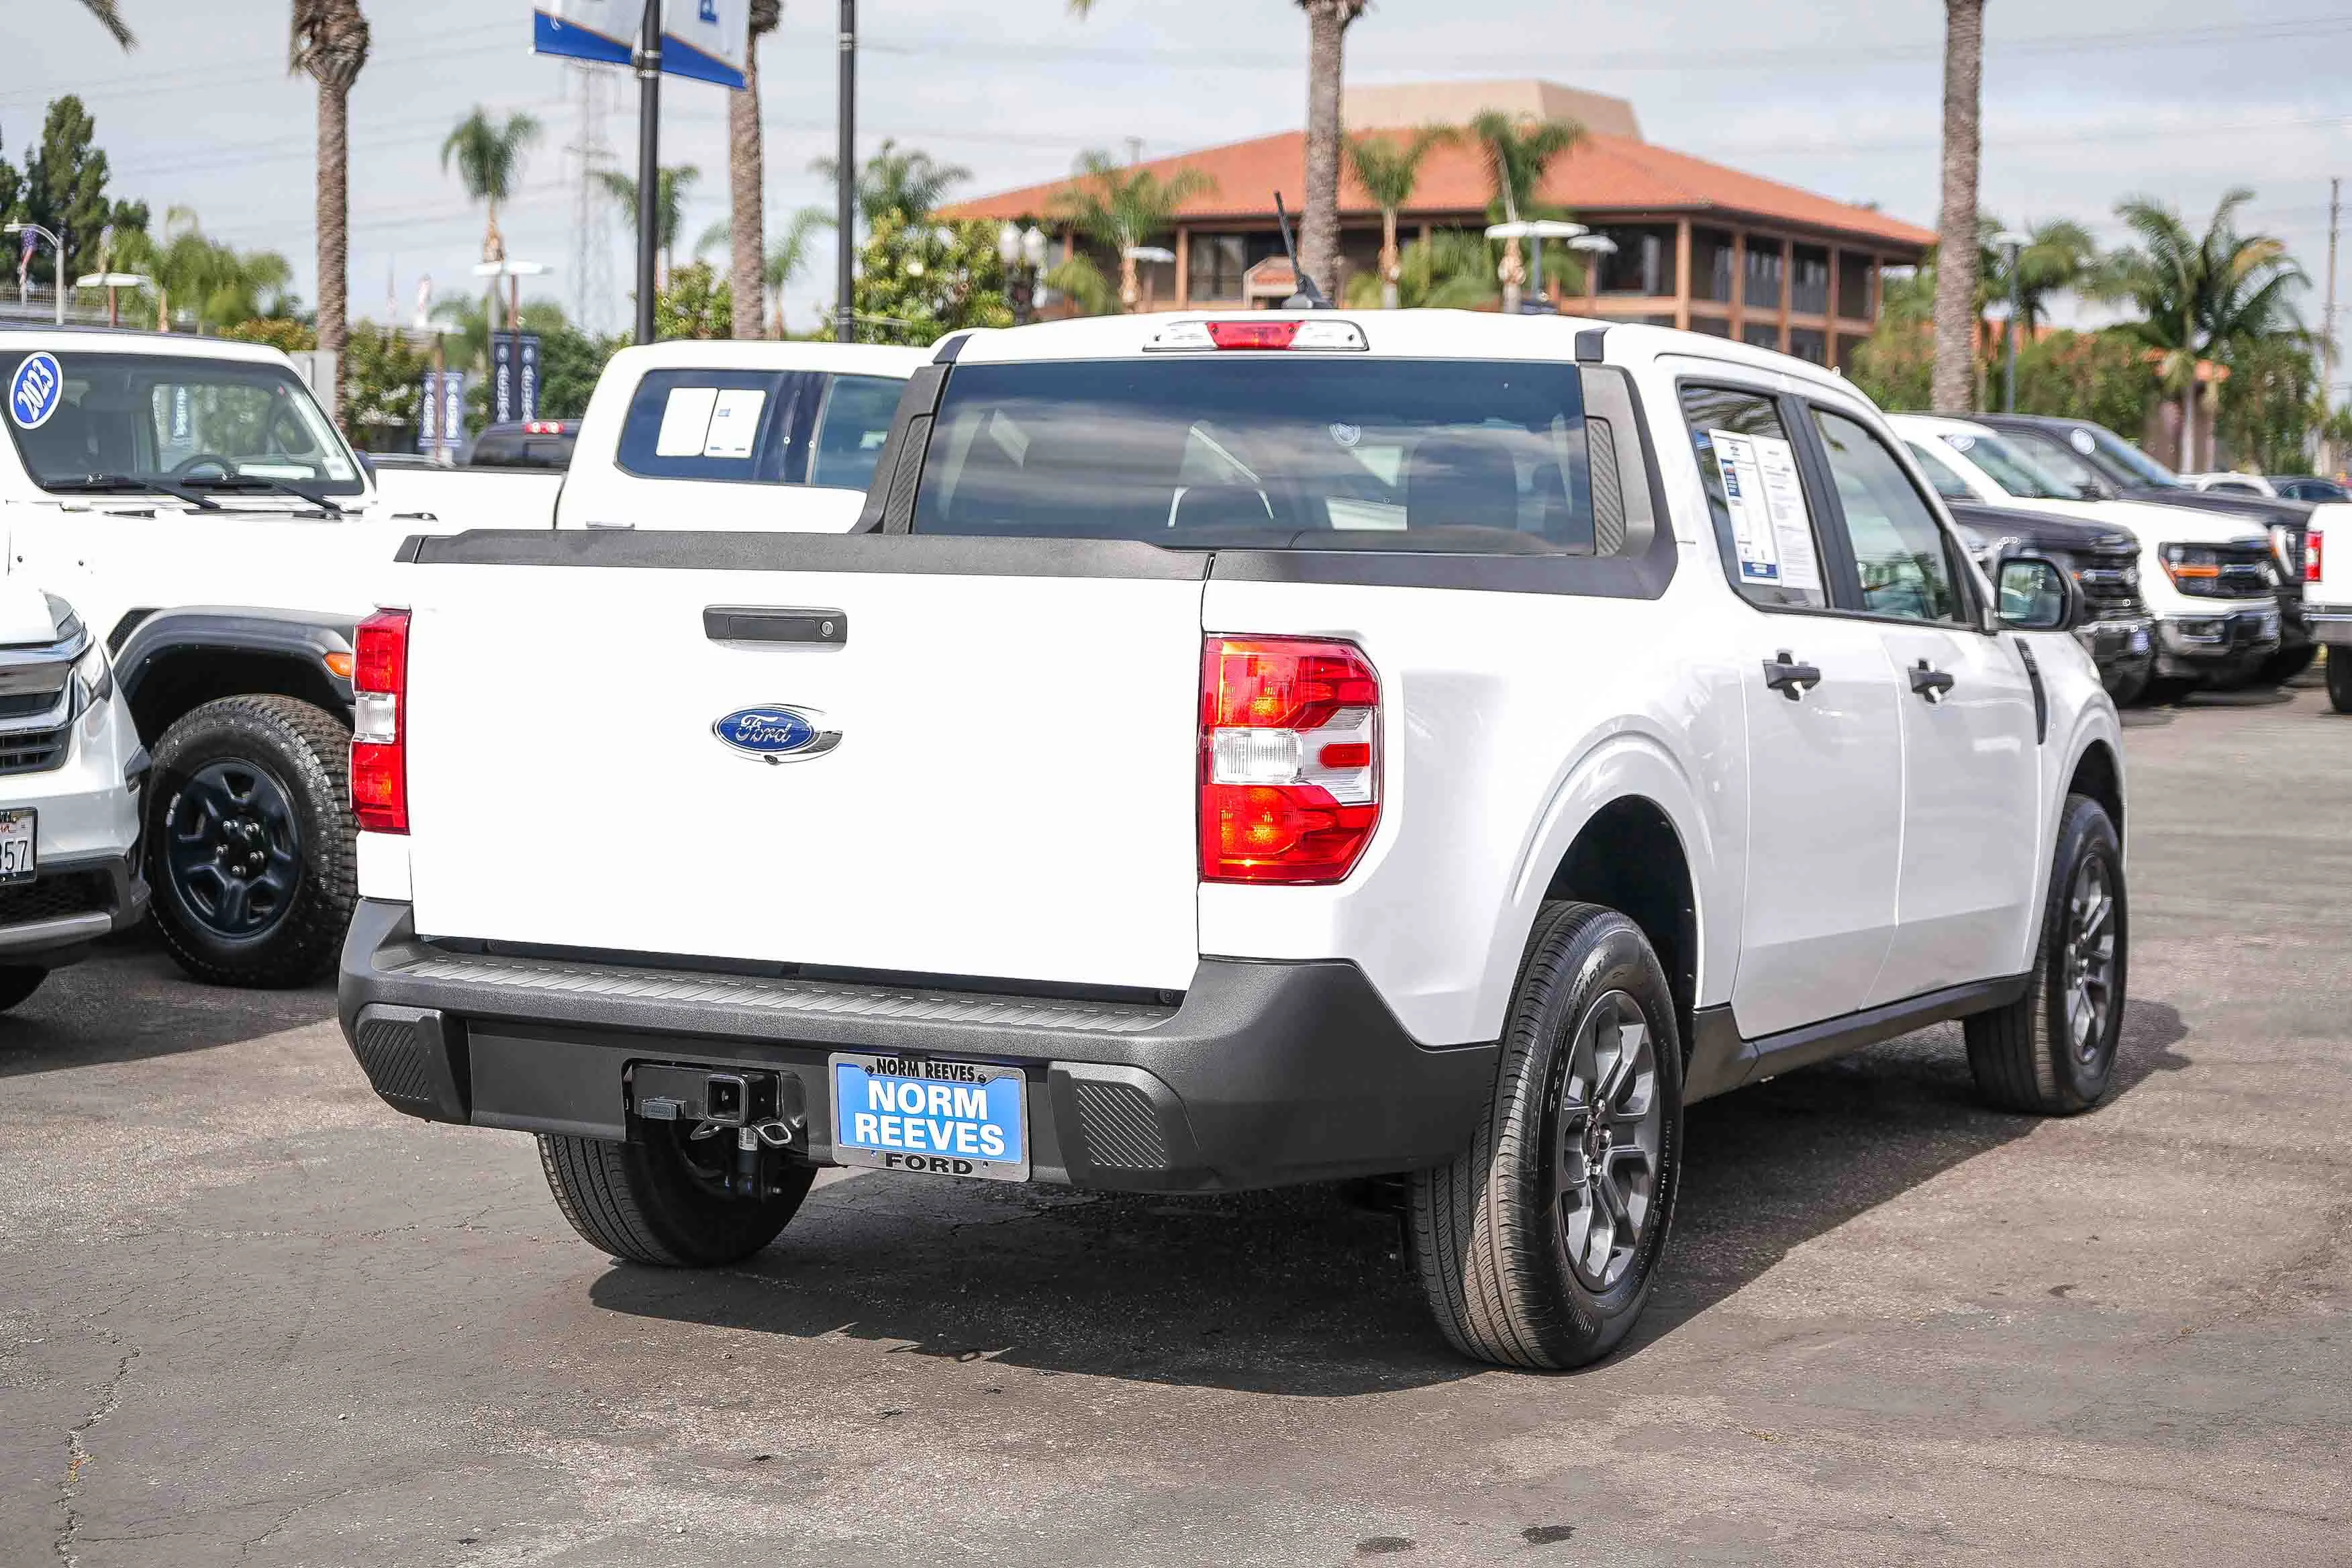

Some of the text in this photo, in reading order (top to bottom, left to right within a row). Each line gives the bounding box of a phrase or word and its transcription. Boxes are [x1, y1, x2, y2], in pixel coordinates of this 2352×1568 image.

[17, 358, 54, 422] 2023
[735, 714, 793, 744] Ford
[0, 839, 28, 871] 57
[876, 1058, 975, 1082] NORM REEVES
[868, 1079, 988, 1121] NORM
[854, 1112, 1006, 1157] REEVES
[885, 1153, 973, 1175] FORD
